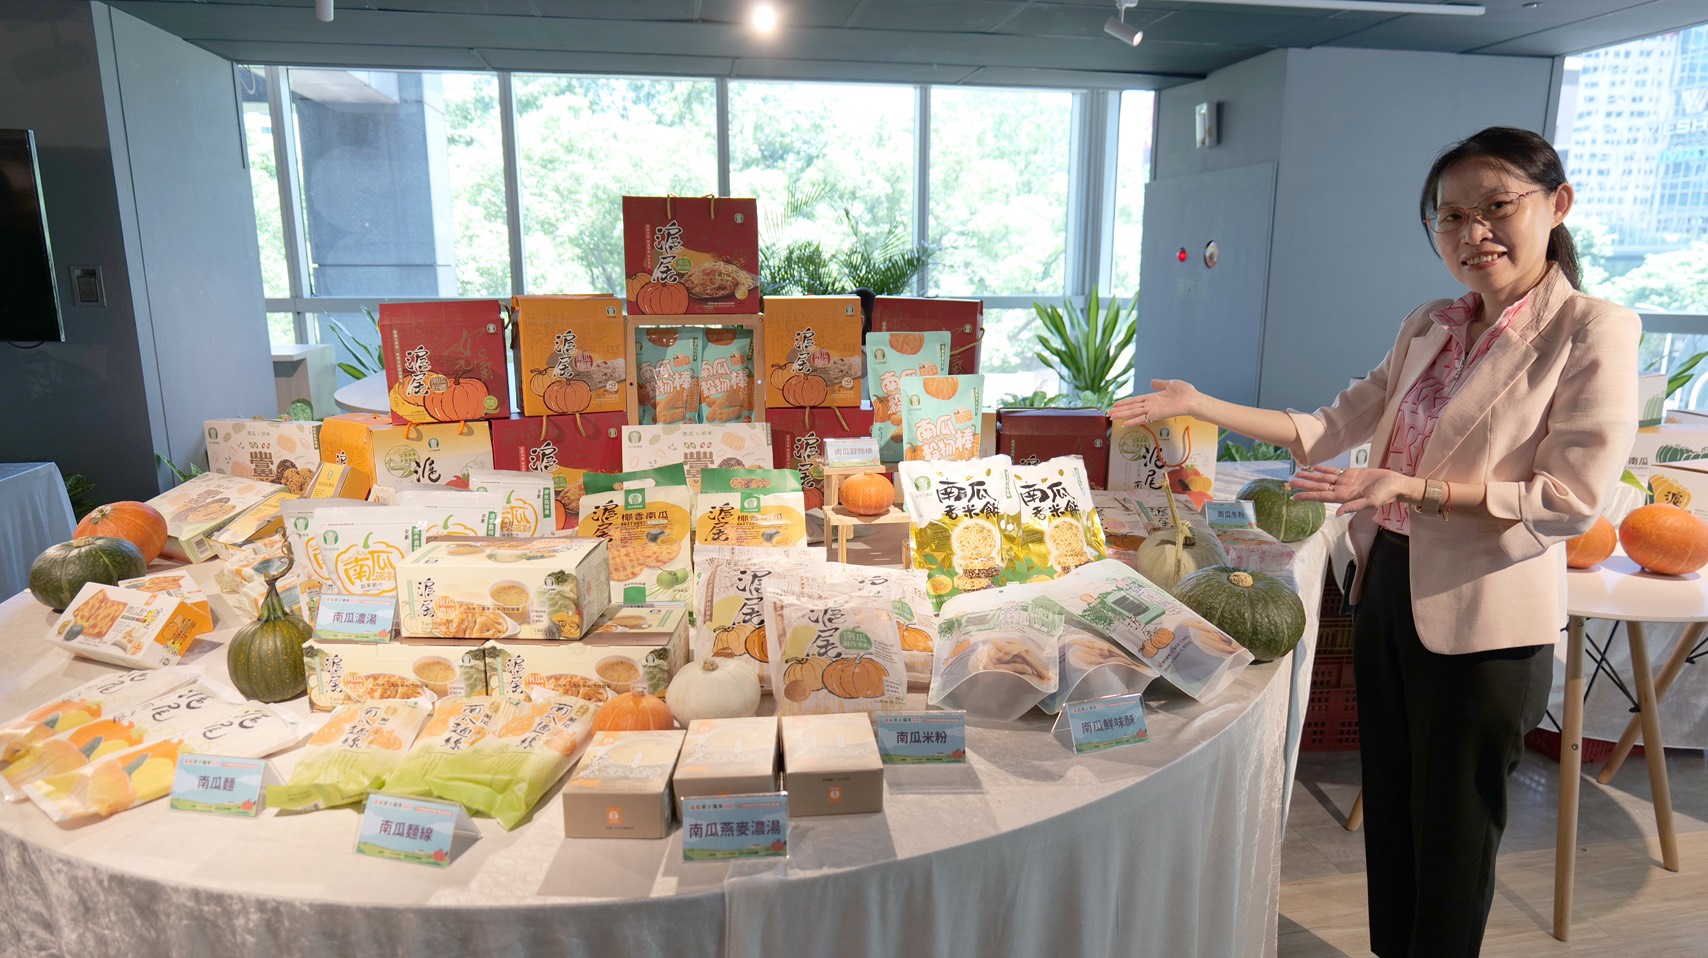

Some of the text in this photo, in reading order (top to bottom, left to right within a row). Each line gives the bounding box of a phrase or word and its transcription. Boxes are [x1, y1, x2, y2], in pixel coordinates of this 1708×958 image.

[915, 415, 956, 441] 南瓜
[922, 426, 975, 461] 穀物棒
[936, 479, 997, 504] 南瓜
[1020, 481, 1076, 506] 南瓜
[943, 501, 1000, 520] 香米餅
[1032, 499, 1081, 521] 香米餅
[343, 551, 395, 586] 南瓜
[332, 611, 377, 625] 南瓜濃湯
[1081, 714, 1136, 735] 南瓜鮮味酥
[896, 730, 948, 744] 南瓜米粉
[197, 775, 236, 792] 南瓜麵
[379, 819, 434, 842] 南瓜麵線
[689, 819, 782, 838] 南瓜燕麥濃湯
